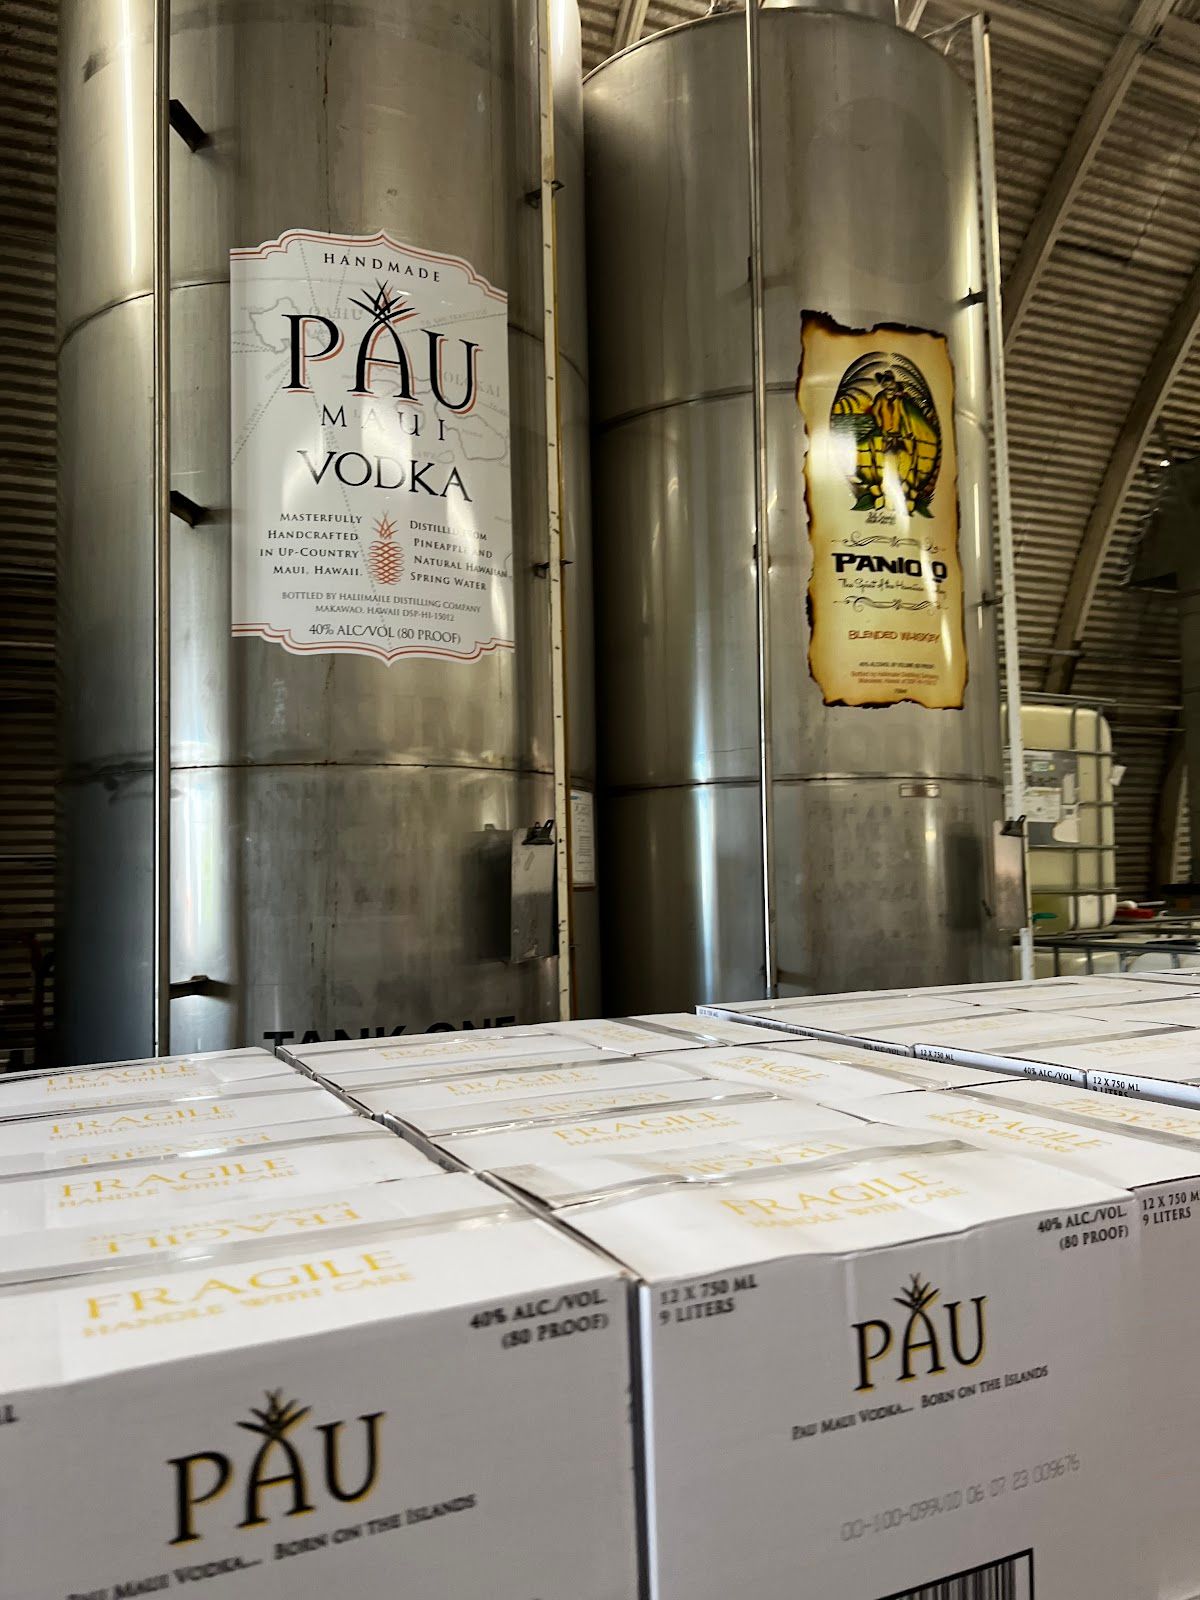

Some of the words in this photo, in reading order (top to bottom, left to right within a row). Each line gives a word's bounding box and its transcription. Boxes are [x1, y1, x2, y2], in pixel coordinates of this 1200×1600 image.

[323, 252, 441, 283] HANDMADE
[281, 277, 484, 415] PAU
[320, 403, 447, 442] MAUI
[296, 449, 474, 503] VODKA
[279, 512, 363, 524] MASTERFULLY
[267, 529, 359, 541] HANDCRAFTED
[259, 548, 274, 557] IN
[278, 547, 360, 559] UP-COUNTRY
[413, 554, 463, 570] NATURAL
[281, 591, 324, 600] BOTTLED
[326, 592, 338, 601] BY
[410, 571, 451, 585] SPRING
[453, 576, 487, 591] WATER
[308, 623, 335, 636] 40%
[396, 627, 415, 640] (80
[417, 629, 462, 645] PROOF)
[1092, 1076, 1103, 1086] 12
[1103, 1078, 1111, 1087] X
[1111, 1080, 1126, 1089] 750
[1127, 1083, 1141, 1092] ML
[51, 1103, 234, 1134] FRAGILE
[551, 1110, 732, 1142] FRAGILE
[945, 1108, 1113, 1149] FRAGILE
[61, 1155, 296, 1198] FRAGILE
[719, 1169, 945, 1217] FRAGILE
[1142, 1197, 1155, 1211] 12
[1157, 1196, 1166, 1208] X
[1168, 1192, 1187, 1207] 750
[1037, 1217, 1063, 1233] 40%
[1142, 1215, 1149, 1226] 9
[1153, 1206, 1192, 1225] LITERS
[1059, 1235, 1079, 1251] (80
[1083, 1225, 1129, 1246] PROOF)
[84, 1248, 410, 1320] FRAGILE
[659, 1288, 681, 1306] 12
[682, 1286, 697, 1301] X
[701, 1278, 730, 1297] 750
[733, 1274, 759, 1291] ML
[82, 1304, 226, 1338] HANDLE
[239, 1286, 324, 1308] WITH
[333, 1271, 416, 1293] CARE
[468, 1307, 507, 1329] 40%
[658, 1309, 670, 1327] 9
[674, 1297, 736, 1323] LITERS
[501, 1328, 532, 1350] (80
[537, 1313, 610, 1341] PROOF)
[850, 1273, 992, 1394] PAU
[920, 1389, 956, 1409] BORN
[957, 1383, 977, 1400] ON
[979, 1377, 1002, 1395] THE
[1003, 1364, 1049, 1389] ISLANDS
[166, 1389, 388, 1546] PAU
[1012, 1469, 1029, 1491] 23
